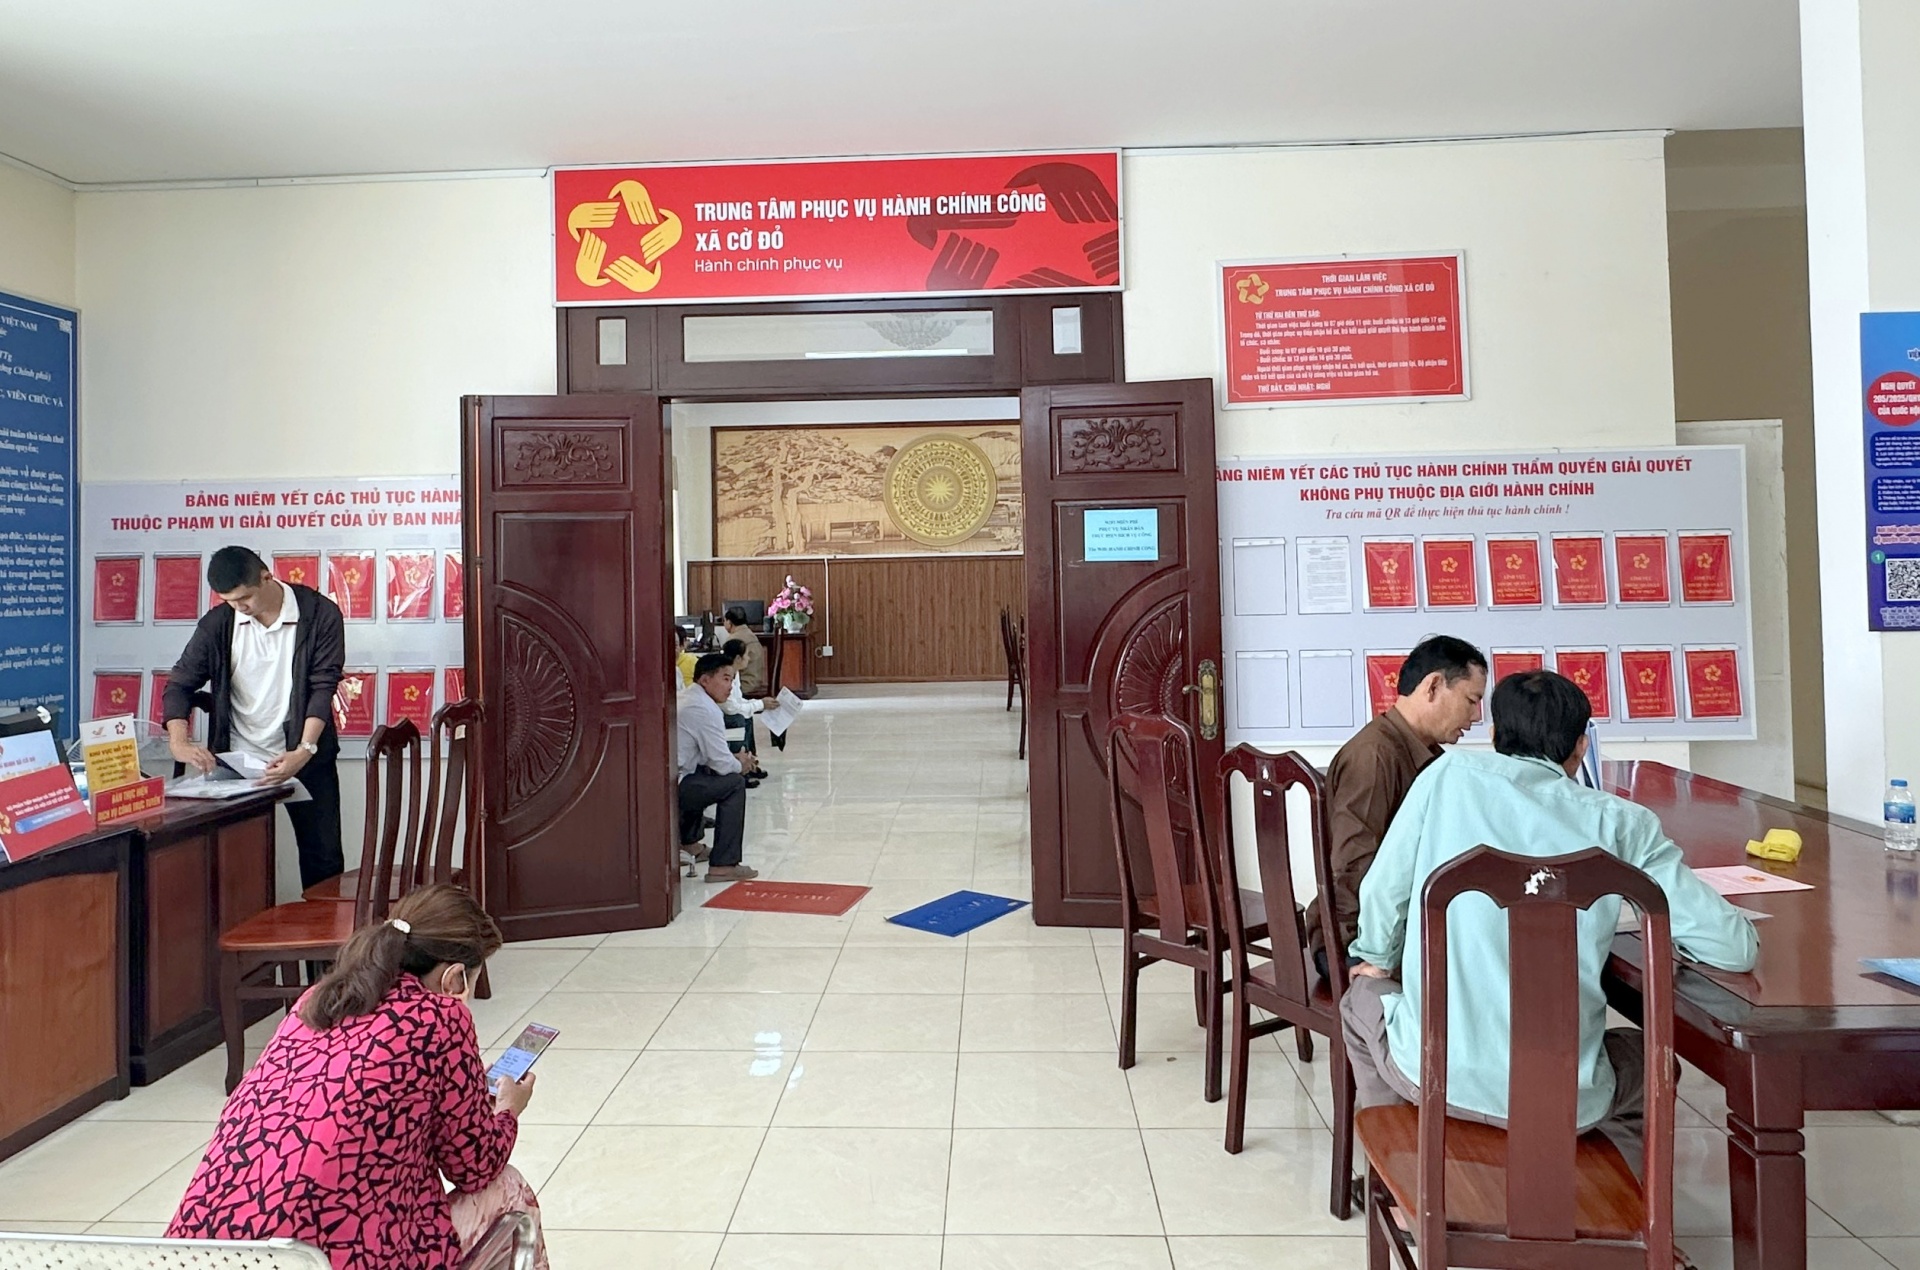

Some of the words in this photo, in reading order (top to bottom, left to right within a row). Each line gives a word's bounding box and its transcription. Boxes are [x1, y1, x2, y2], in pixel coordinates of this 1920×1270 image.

[695, 202, 752, 222] TRUNG
[757, 198, 795, 220] TÂM
[801, 200, 849, 223] PHỤC
[854, 198, 876, 222] VỤ
[882, 193, 931, 216] HÀNH
[937, 192, 992, 215] CHÍNH
[997, 192, 1046, 213] CÔNG
[695, 230, 721, 252] XÃ
[727, 228, 753, 251] CỜ
[758, 225, 784, 250] ĐỎ
[695, 258, 733, 273] Hành
[737, 256, 779, 271] chính
[783, 257, 822, 274] phục
[825, 258, 843, 271] vụ
[1322, 273, 1336, 283] THỜI
[1338, 274, 1354, 282] GIAN
[1356, 272, 1371, 281] LÀM
[1372, 272, 1387, 282] VIỆC
[1275, 288, 1297, 297] TRUNG
[1298, 287, 1312, 296] TÂM
[1314, 287, 1332, 296] PHỤC
[1333, 286, 1342, 296] VỤ
[1343, 285, 1361, 294] HÀNH
[1363, 284, 1383, 294] CHÍNH
[1385, 283, 1403, 292] CÔNG
[1404, 283, 1414, 292] XÃ
[1415, 283, 1424, 291] CỜ
[1425, 281, 1435, 291] ĐỎ
[1, 316, 19, 327] VIỆT
[20, 320, 38, 331] NAM
[7, 390, 27, 401] VIÊN
[28, 394, 52, 405] CHỨC
[53, 397, 63, 407] VÀ
[1910, 405, 1920, 416] HỘ
[1216, 466, 1242, 481] ẢNG
[1247, 466, 1285, 480] NIÊM
[1290, 463, 1315, 480] YẾT
[1320, 464, 1348, 479] CÁC
[1353, 461, 1381, 479] THỦ
[1385, 465, 1412, 480] TỤC
[1418, 462, 1457, 477] HÀNH
[1462, 460, 1508, 477] CHÍNH
[1512, 457, 1554, 474] THẨM
[1558, 457, 1606, 475] QUYỀN
[1612, 456, 1642, 473] GIẢI
[1646, 455, 1692, 474] QUYẾT
[186, 490, 229, 507] BẢNG
[234, 491, 276, 506] NIÊM
[281, 489, 308, 505] YẾT
[314, 490, 345, 505] CÁC
[351, 487, 380, 504] THỦ
[386, 490, 415, 506] TỤC
[421, 488, 462, 503] HÀNH
[1300, 485, 1350, 501] KHÔNG
[1355, 487, 1384, 502] PHỤ
[1388, 484, 1435, 502] THUỘC
[1440, 486, 1464, 501] ĐỊA
[1469, 482, 1499, 498] GIỚI
[1504, 480, 1544, 496] HÀNH
[1550, 479, 1595, 495] CHÍNH
[111, 514, 162, 533] THUỘC
[168, 516, 214, 532] PHẠM
[219, 516, 234, 528] VI
[240, 511, 271, 528] GIẢI
[276, 510, 325, 528] QUYẾT
[330, 510, 362, 526] CỦA
[368, 509, 387, 526] ỦY
[393, 512, 426, 526] BAN
[432, 509, 462, 525] NHÂ
[1326, 509, 1342, 519] Tra
[1345, 508, 1363, 519] cứu
[1367, 508, 1382, 518] mã
[1385, 508, 1401, 520] QR
[1404, 504, 1415, 517] để
[1418, 507, 1440, 520] thực
[1443, 506, 1465, 518] hiện
[1487, 506, 1501, 518] tục
[1505, 505, 1531, 515] hành
[1534, 505, 1562, 514] chính
